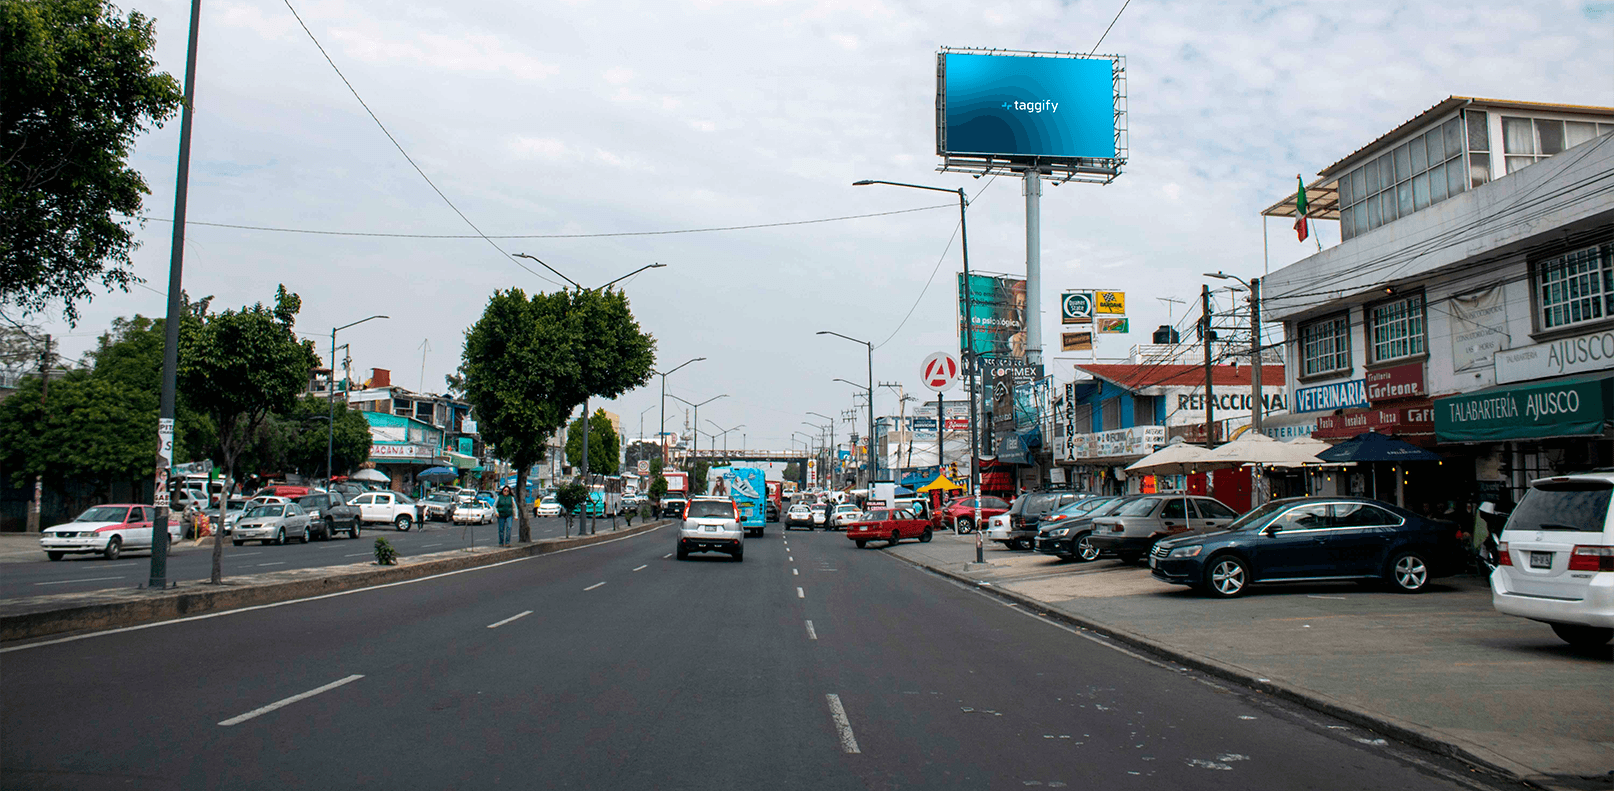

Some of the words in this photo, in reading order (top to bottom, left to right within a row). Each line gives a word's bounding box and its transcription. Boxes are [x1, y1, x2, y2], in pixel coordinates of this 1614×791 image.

[1014, 99, 1059, 113] taggify
[1548, 332, 1614, 374] AJUSCO
[1297, 380, 1368, 411] VETERINARIA
[1368, 382, 1418, 399] Corleone
[1379, 410, 1397, 424] Pizza
[1449, 392, 1519, 422] TALABARTERÍA
[1526, 390, 1580, 421] AJUSCO
